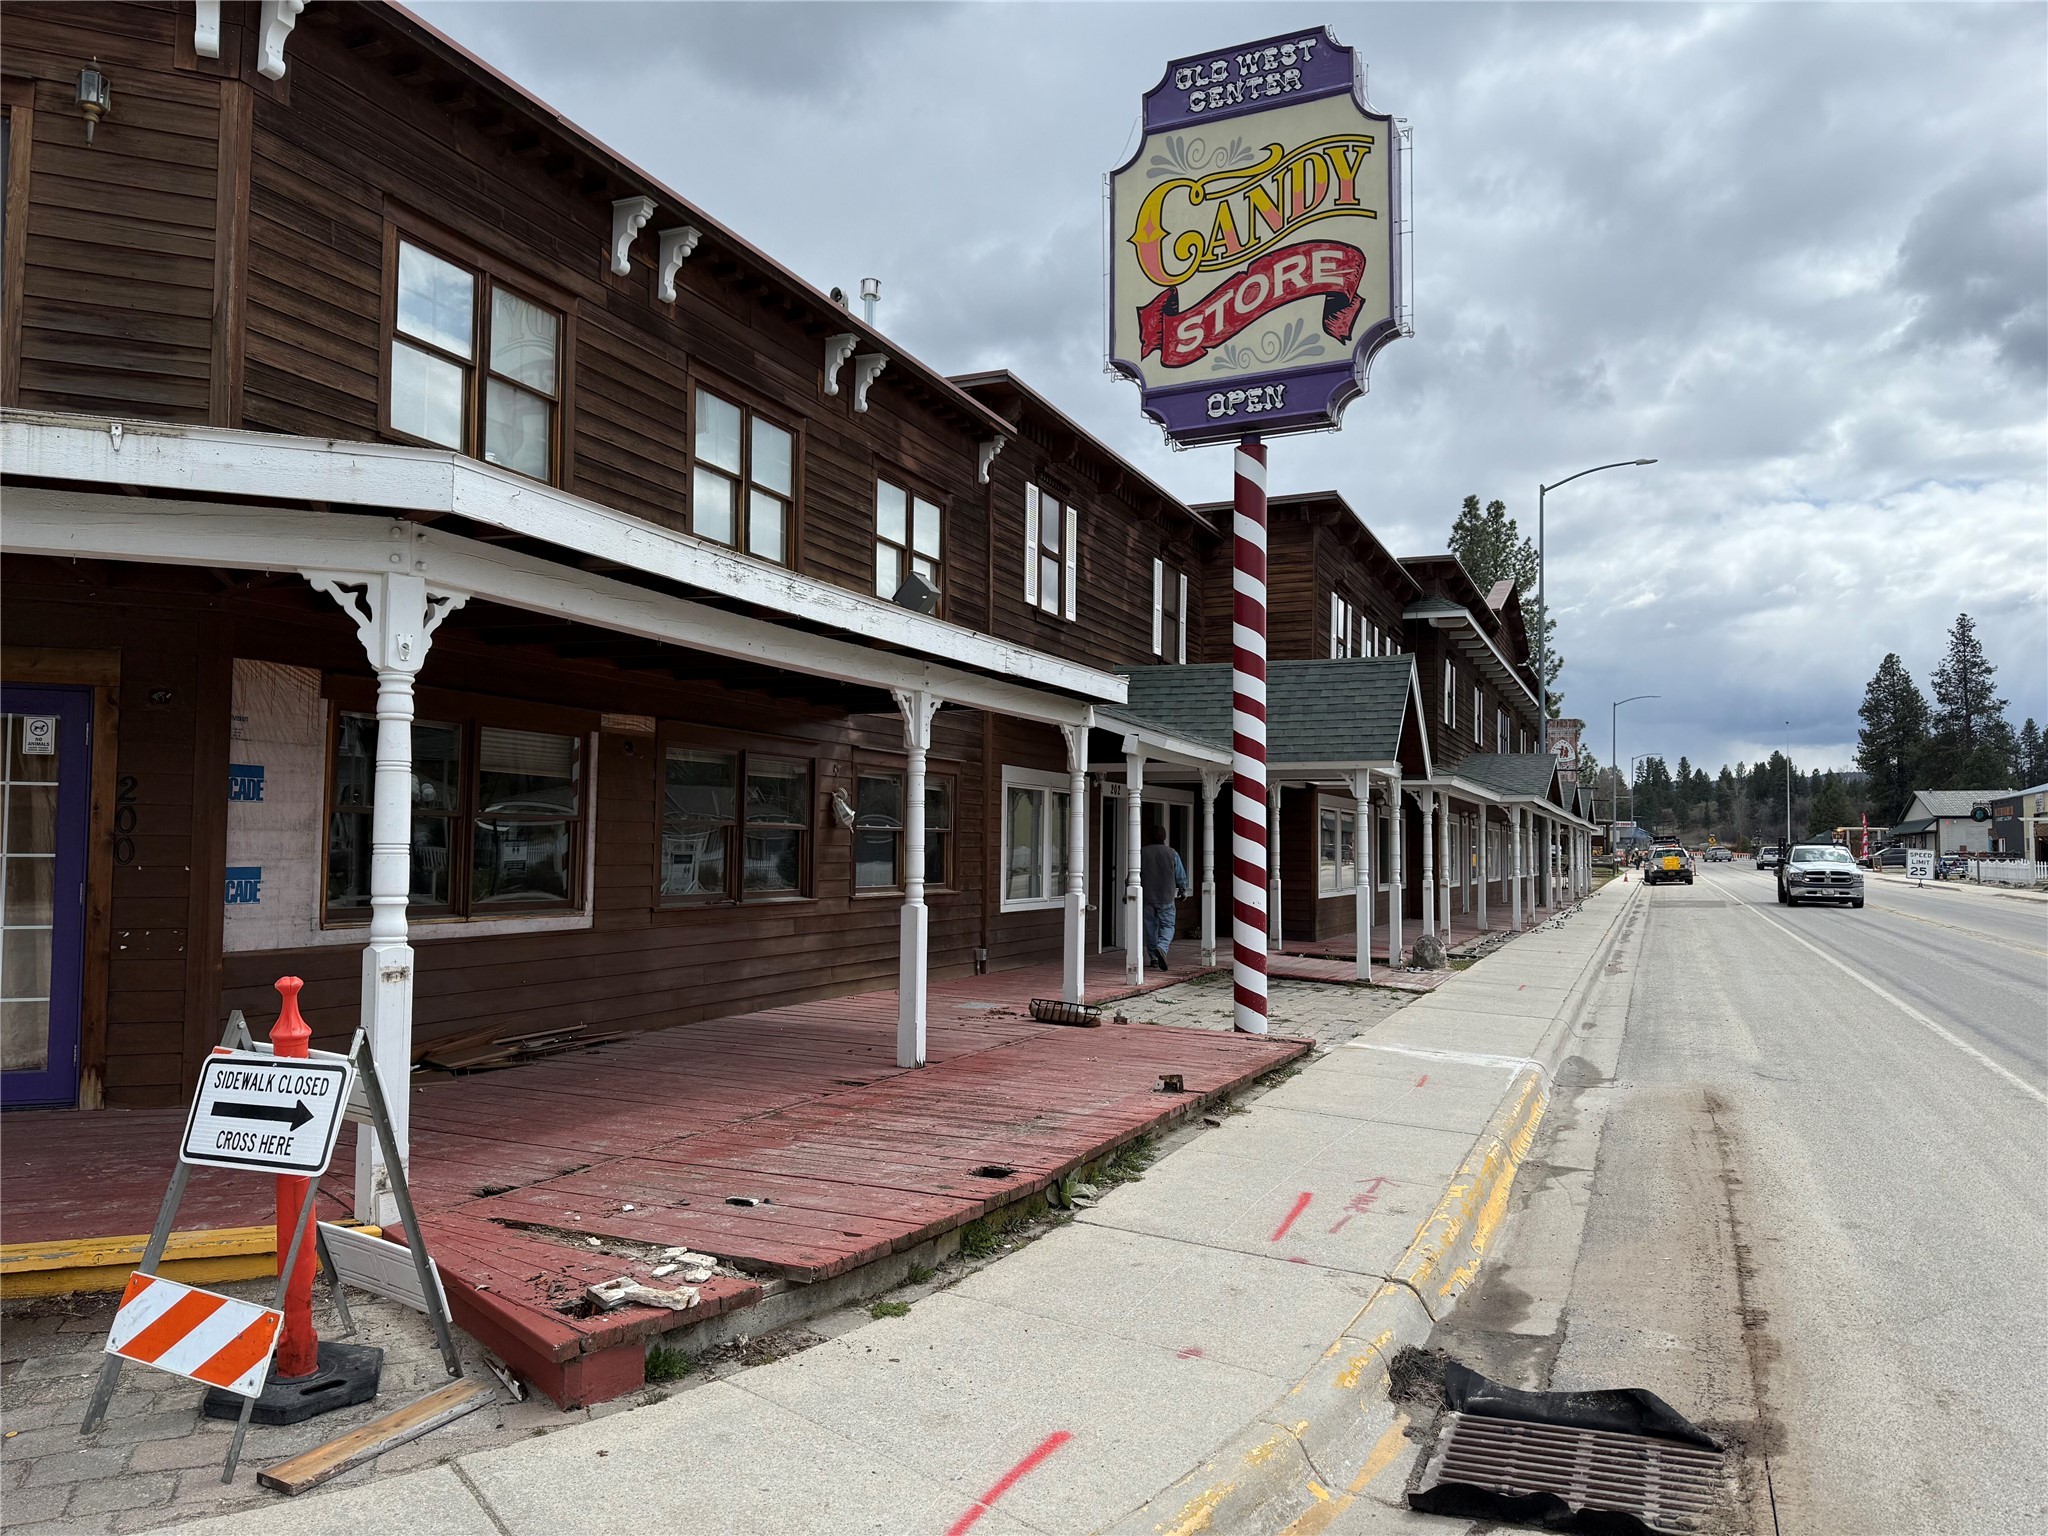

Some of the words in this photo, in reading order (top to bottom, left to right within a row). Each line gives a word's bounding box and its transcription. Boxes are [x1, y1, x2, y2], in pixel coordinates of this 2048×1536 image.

[1175, 60, 1230, 90] OLD
[1236, 38, 1317, 76] WEST
[1189, 68, 1303, 113] CENTER
[1128, 144, 1373, 287] CANDY
[1176, 249, 1350, 354] STORE
[1207, 384, 1286, 418] OPEN
[1110, 783, 1121, 796] 202
[1910, 866, 1927, 876] 25
[225, 880, 261, 904] CADE
[214, 1070, 276, 1093] SIDEWALK
[277, 1074, 330, 1097] CLOSED
[215, 1130, 258, 1152] CROSS
[257, 1134, 295, 1156] HERE
